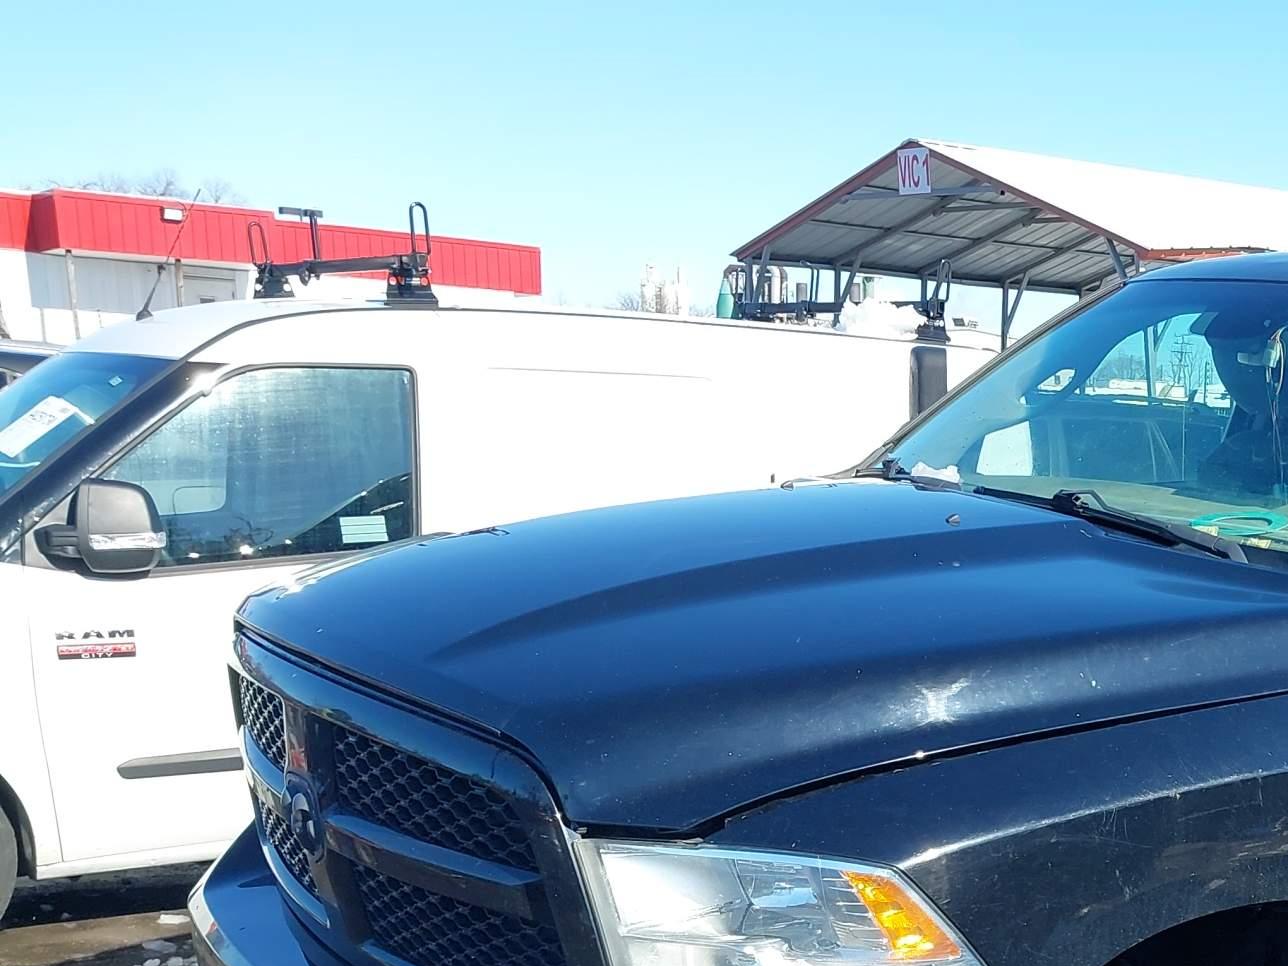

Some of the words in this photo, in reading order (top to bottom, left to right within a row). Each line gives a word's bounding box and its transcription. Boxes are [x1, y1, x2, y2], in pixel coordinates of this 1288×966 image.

[898, 153, 920, 189] VIC
[922, 152, 930, 187] 1
[55, 629, 135, 641] RAM
[81, 652, 114, 660] CITY
